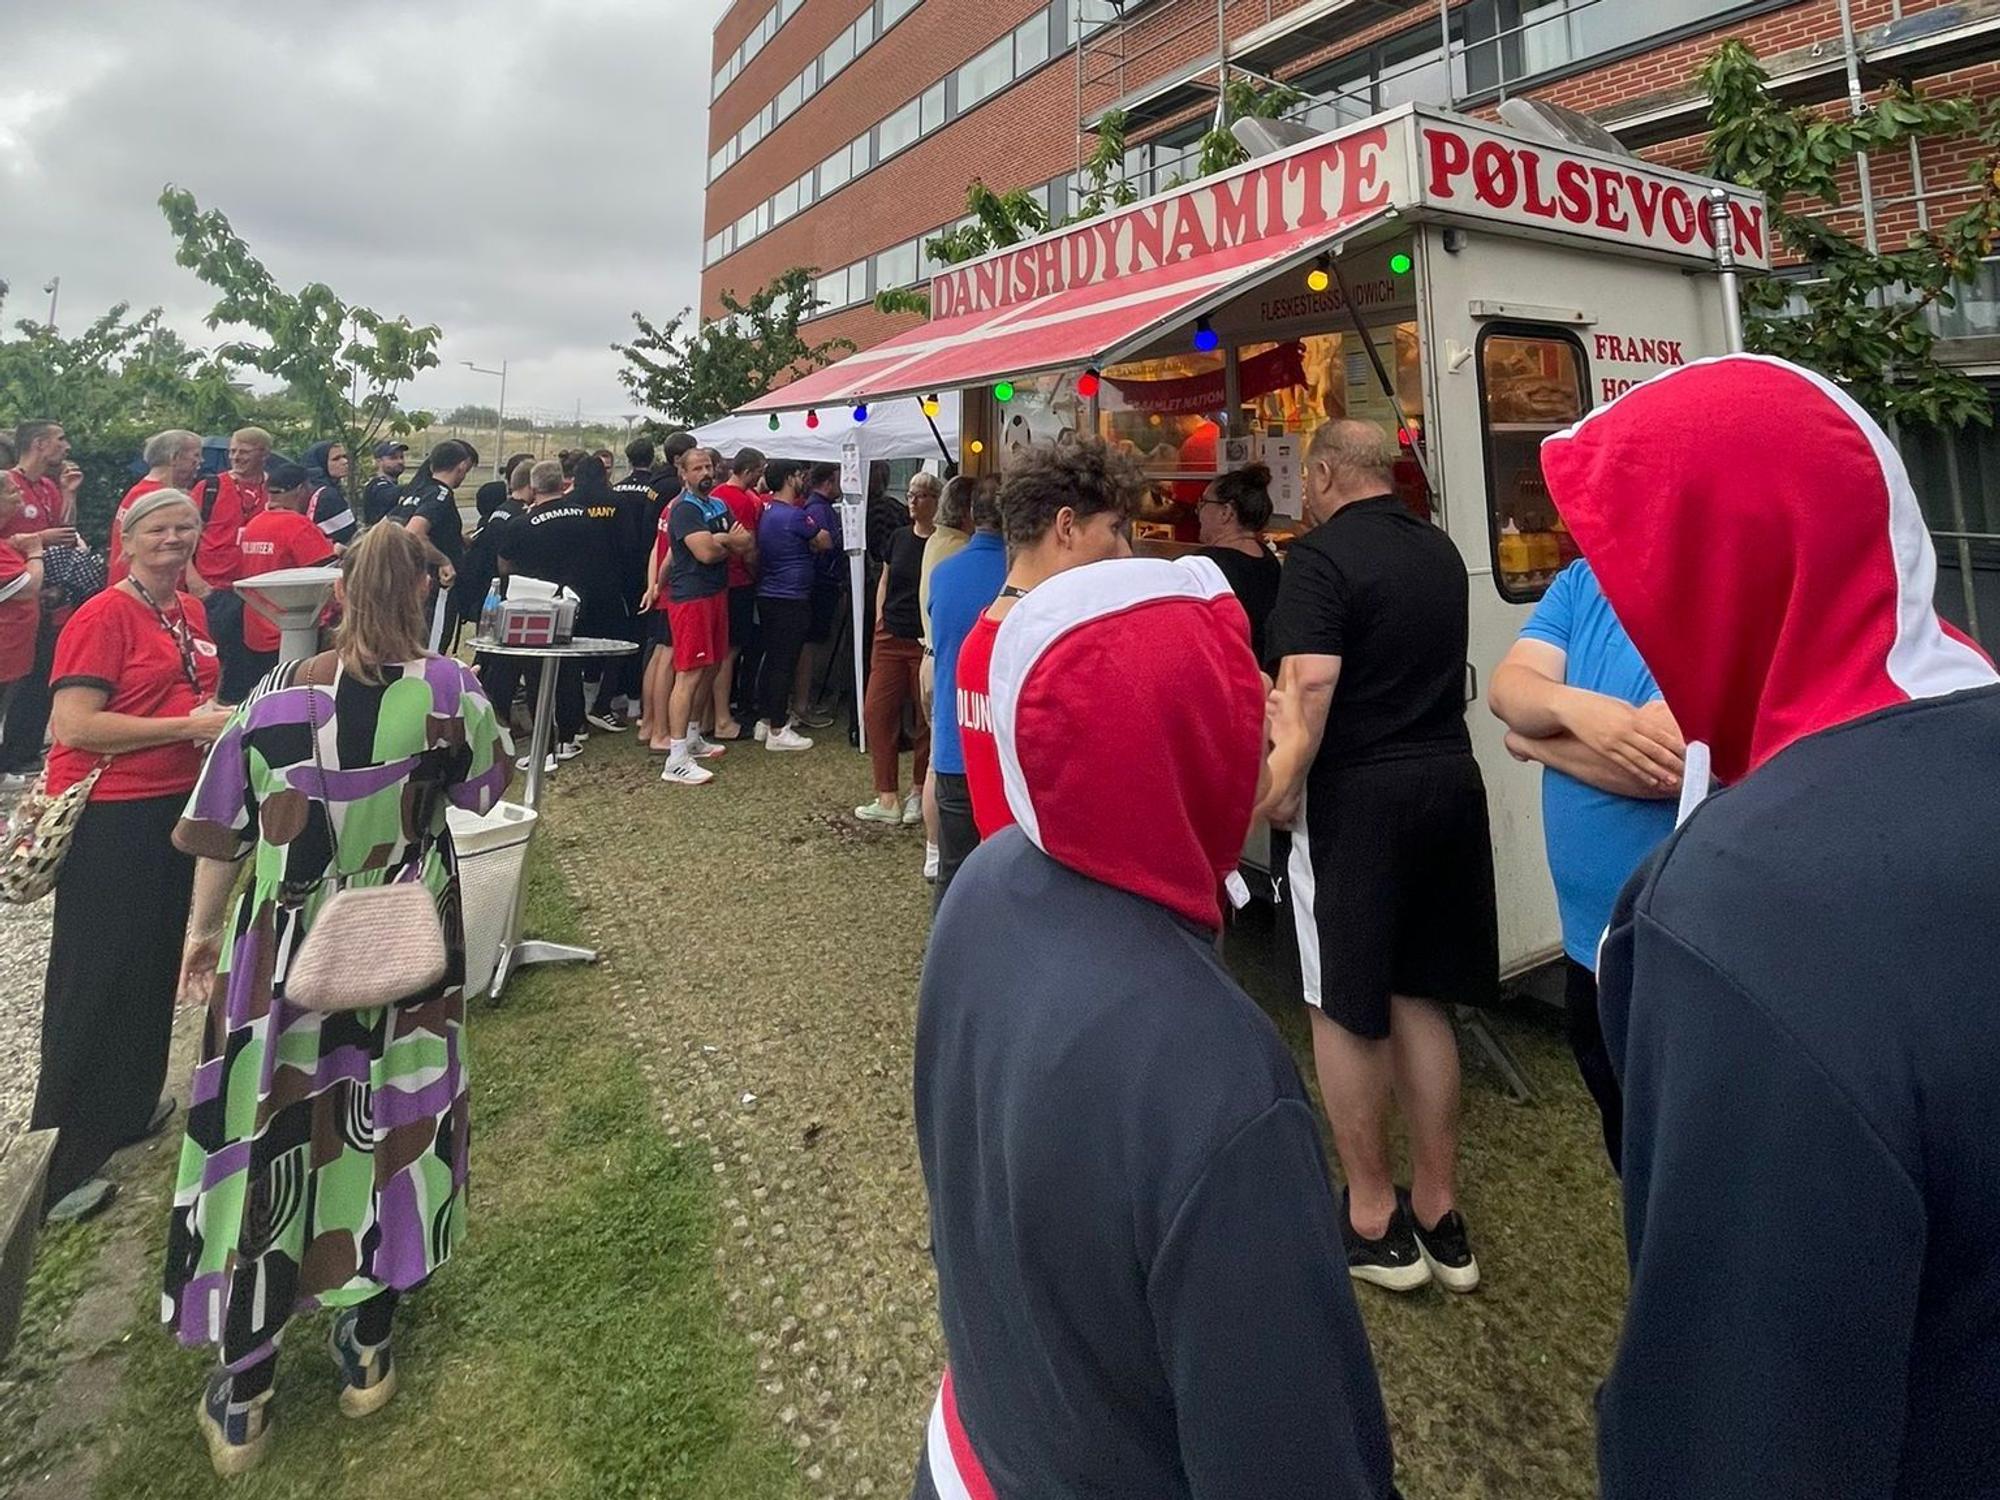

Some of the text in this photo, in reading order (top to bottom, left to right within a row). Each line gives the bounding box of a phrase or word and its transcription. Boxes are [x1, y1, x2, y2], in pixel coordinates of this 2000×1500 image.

[1260, 280, 1396, 321] FLÆSKESTEGSSADWICH
[1594, 334, 1685, 366] FRANSK
[530, 507, 584, 525] GERMANY
